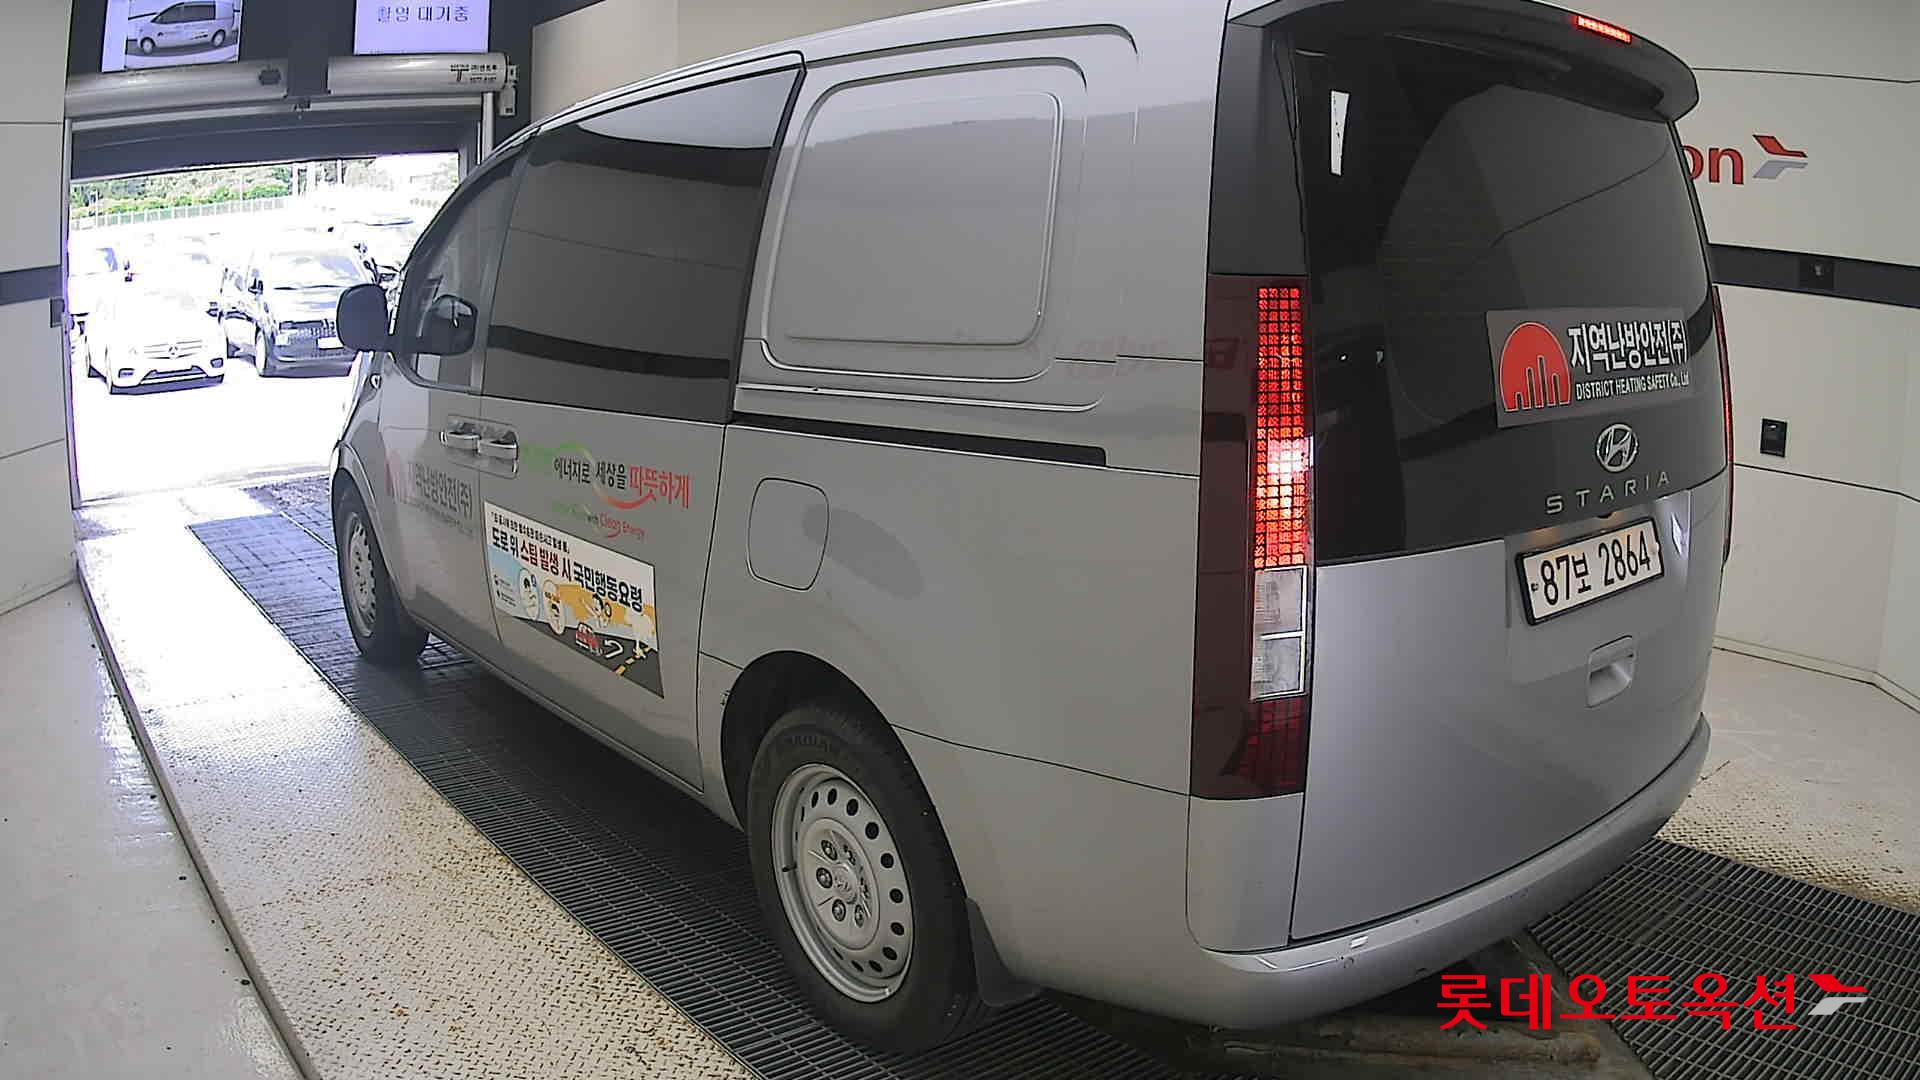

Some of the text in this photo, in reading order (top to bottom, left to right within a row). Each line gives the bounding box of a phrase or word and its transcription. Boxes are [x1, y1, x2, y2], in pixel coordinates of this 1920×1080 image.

[418, 6, 469, 22] 대기중
[1568, 320, 1688, 373] 지역난방안전(주)
[1576, 380, 1613, 400] DISTRICT
[1615, 376, 1647, 396] HEATING
[1647, 373, 1670, 392] SAFETY
[554, 456, 690, 509] 에너지로 세상을 따뜻하게
[1546, 471, 1670, 514] STARIA
[520, 538, 539, 567] 스팀
[539, 550, 559, 576] 발생
[561, 556, 572, 582] 시
[573, 560, 643, 613] 국민행동요령
[1540, 530, 1651, 605] 87보 2864
